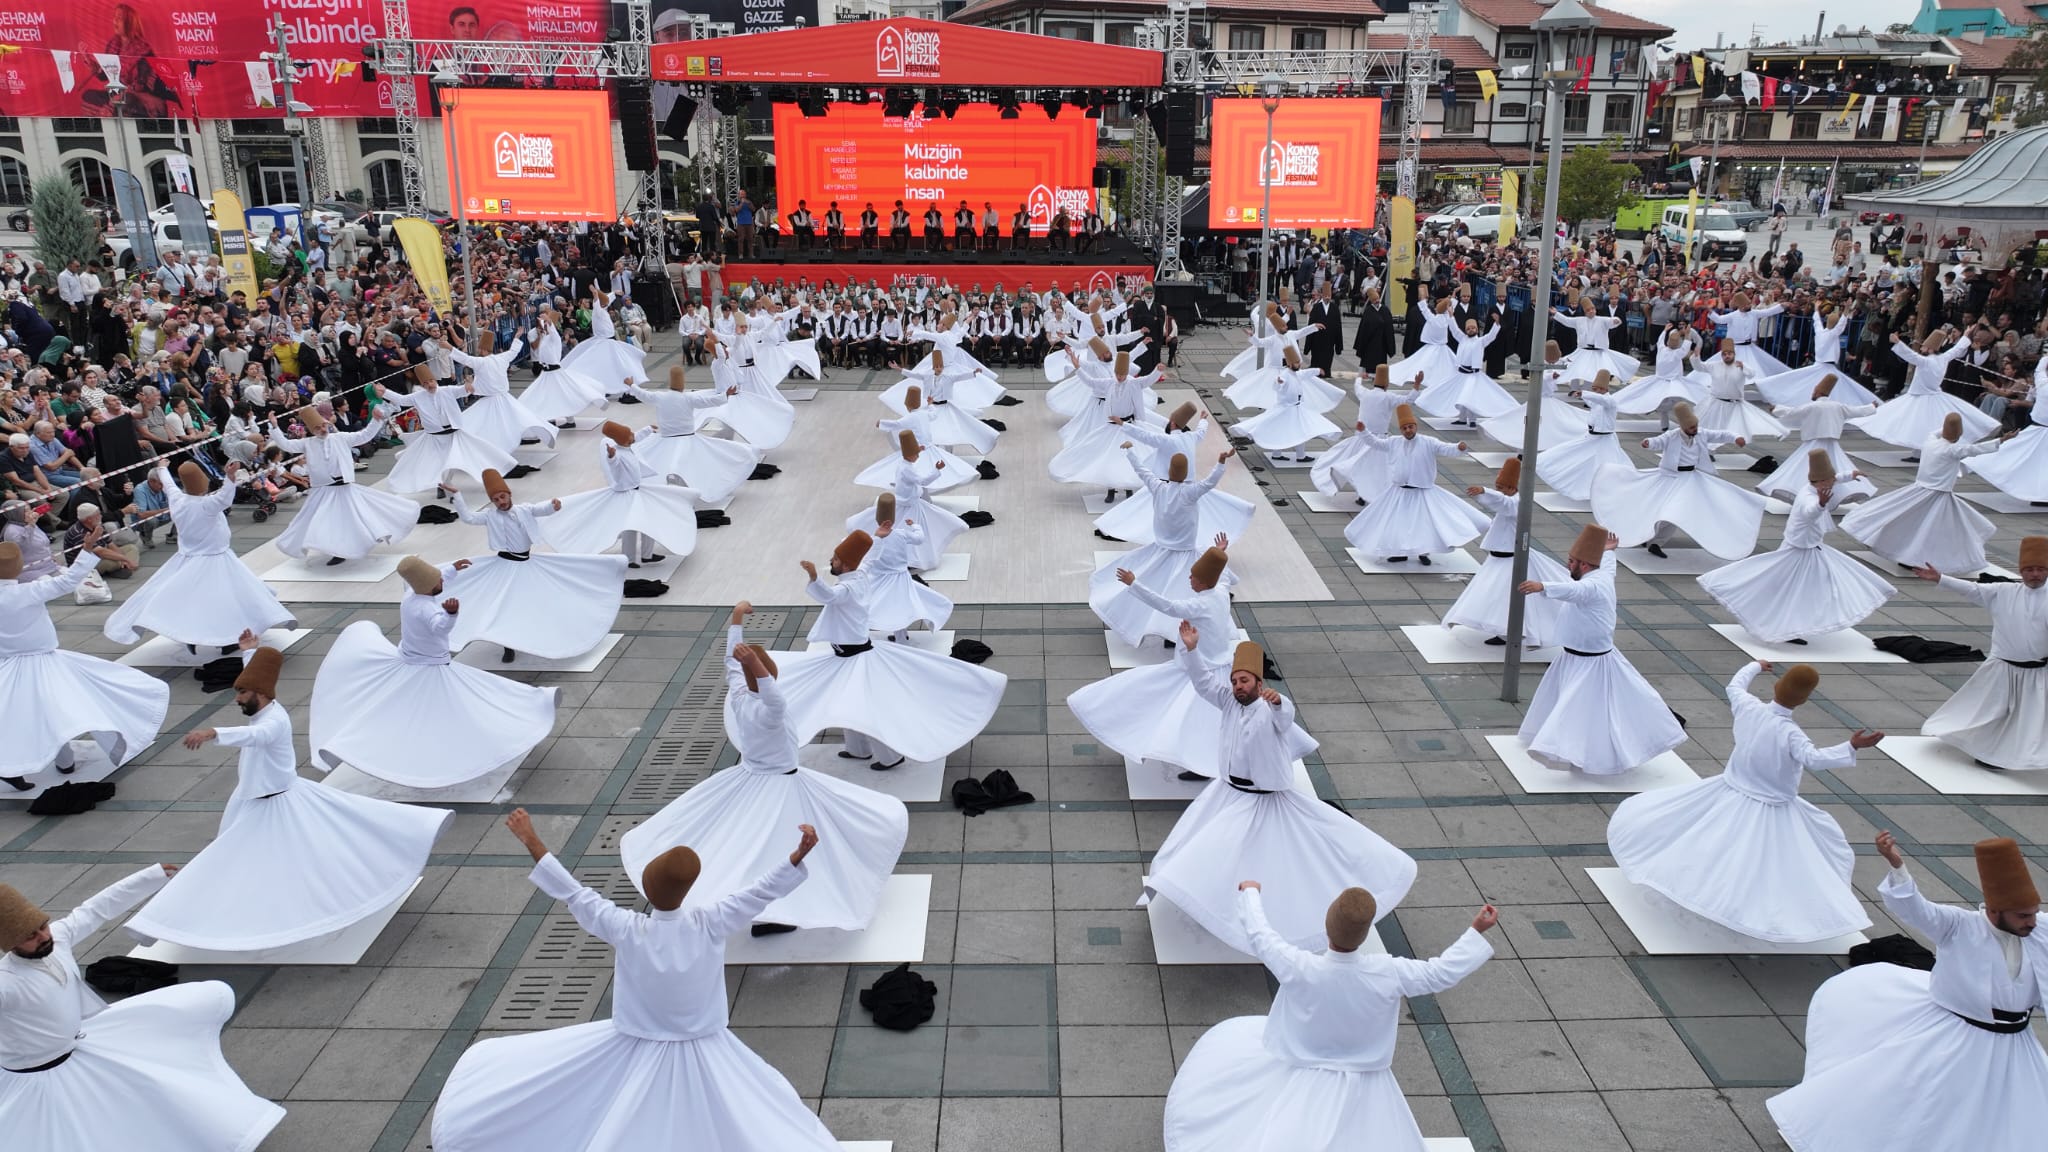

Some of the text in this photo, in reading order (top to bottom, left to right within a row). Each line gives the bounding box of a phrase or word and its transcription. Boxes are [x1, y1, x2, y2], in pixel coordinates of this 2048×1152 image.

[172, 11, 217, 26] SANEM
[527, 4, 581, 18] MİRALEM
[744, 10, 785, 24] GAZZE
[528, 18, 598, 33] MİRALEMOV
[0, 26, 42, 42] NAZERİ
[175, 27, 215, 42] MARVİ
[904, 31, 940, 43] KONYA
[275, 53, 353, 84] onya
[520, 137, 553, 148] KONYA
[904, 143, 962, 164] Müziğin
[1287, 145, 1320, 156] KONYA
[904, 163, 968, 181] kalbinde
[905, 182, 945, 200] insan
[1055, 189, 1090, 200] KONYA
[893, 273, 937, 288] Müzin
